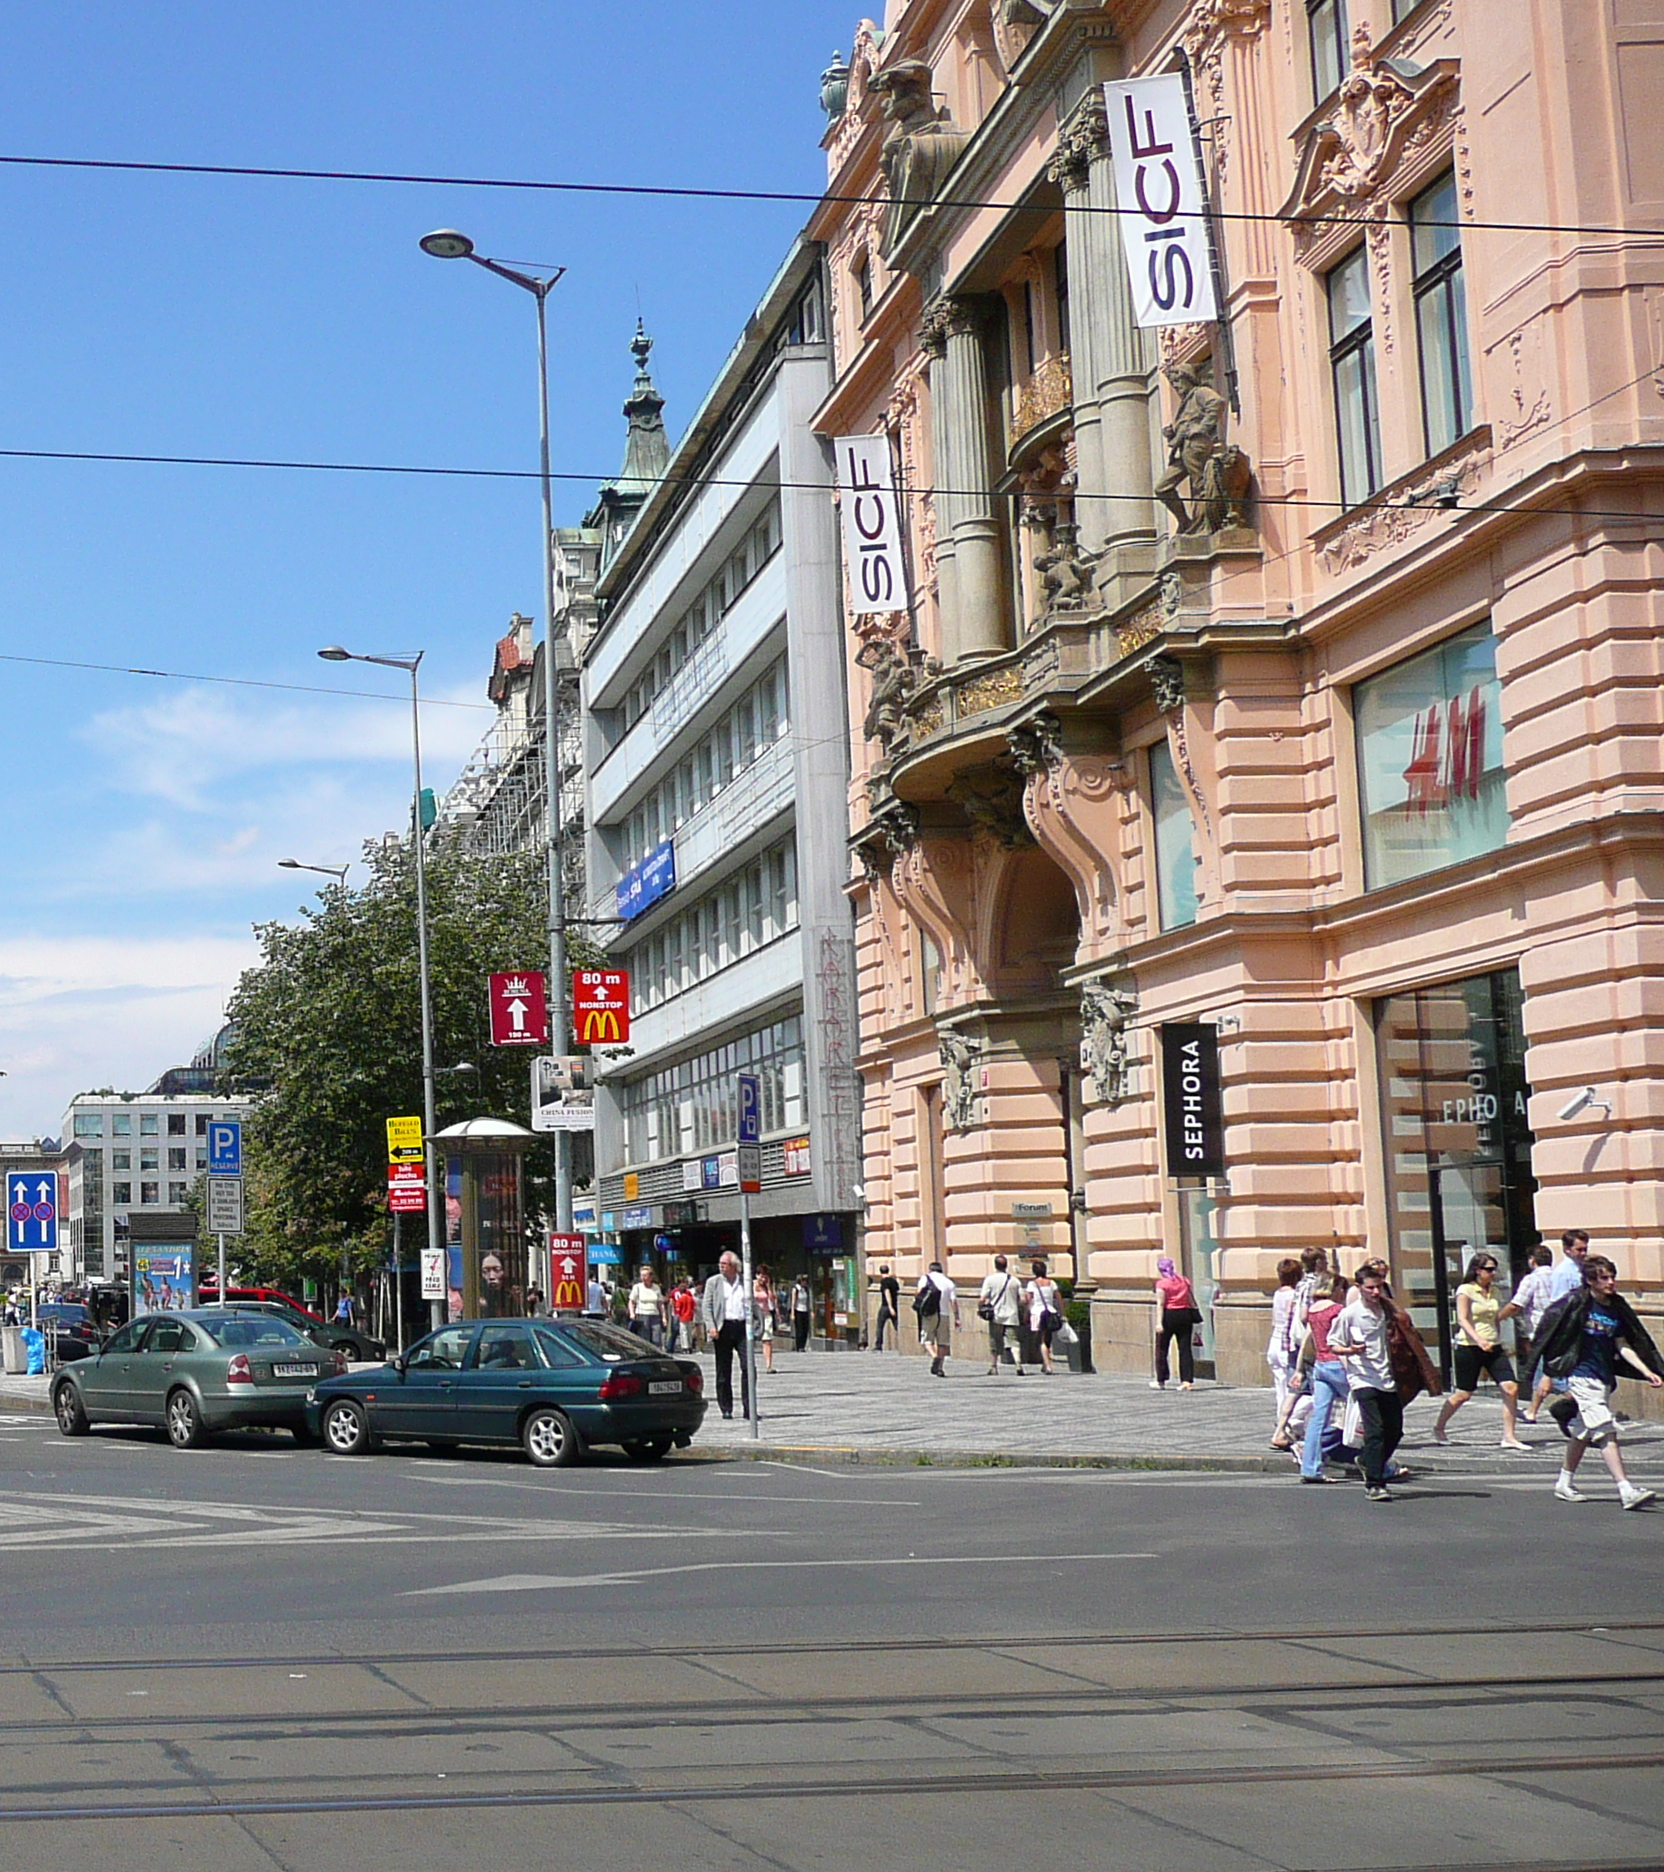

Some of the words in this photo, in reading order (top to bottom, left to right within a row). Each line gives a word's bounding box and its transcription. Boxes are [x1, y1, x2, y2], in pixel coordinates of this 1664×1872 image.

[1124, 95, 1194, 311] SICF
[848, 447, 893, 603] SICF
[582, 973, 601, 984] 80
[605, 974, 620, 984] m
[579, 1001, 623, 1009] NONSTOP
[742, 1083, 754, 1121] P
[1180, 1040, 1204, 1160] SEPHORA
[215, 1127, 234, 1158] P
[553, 1238, 568, 1248] 80
